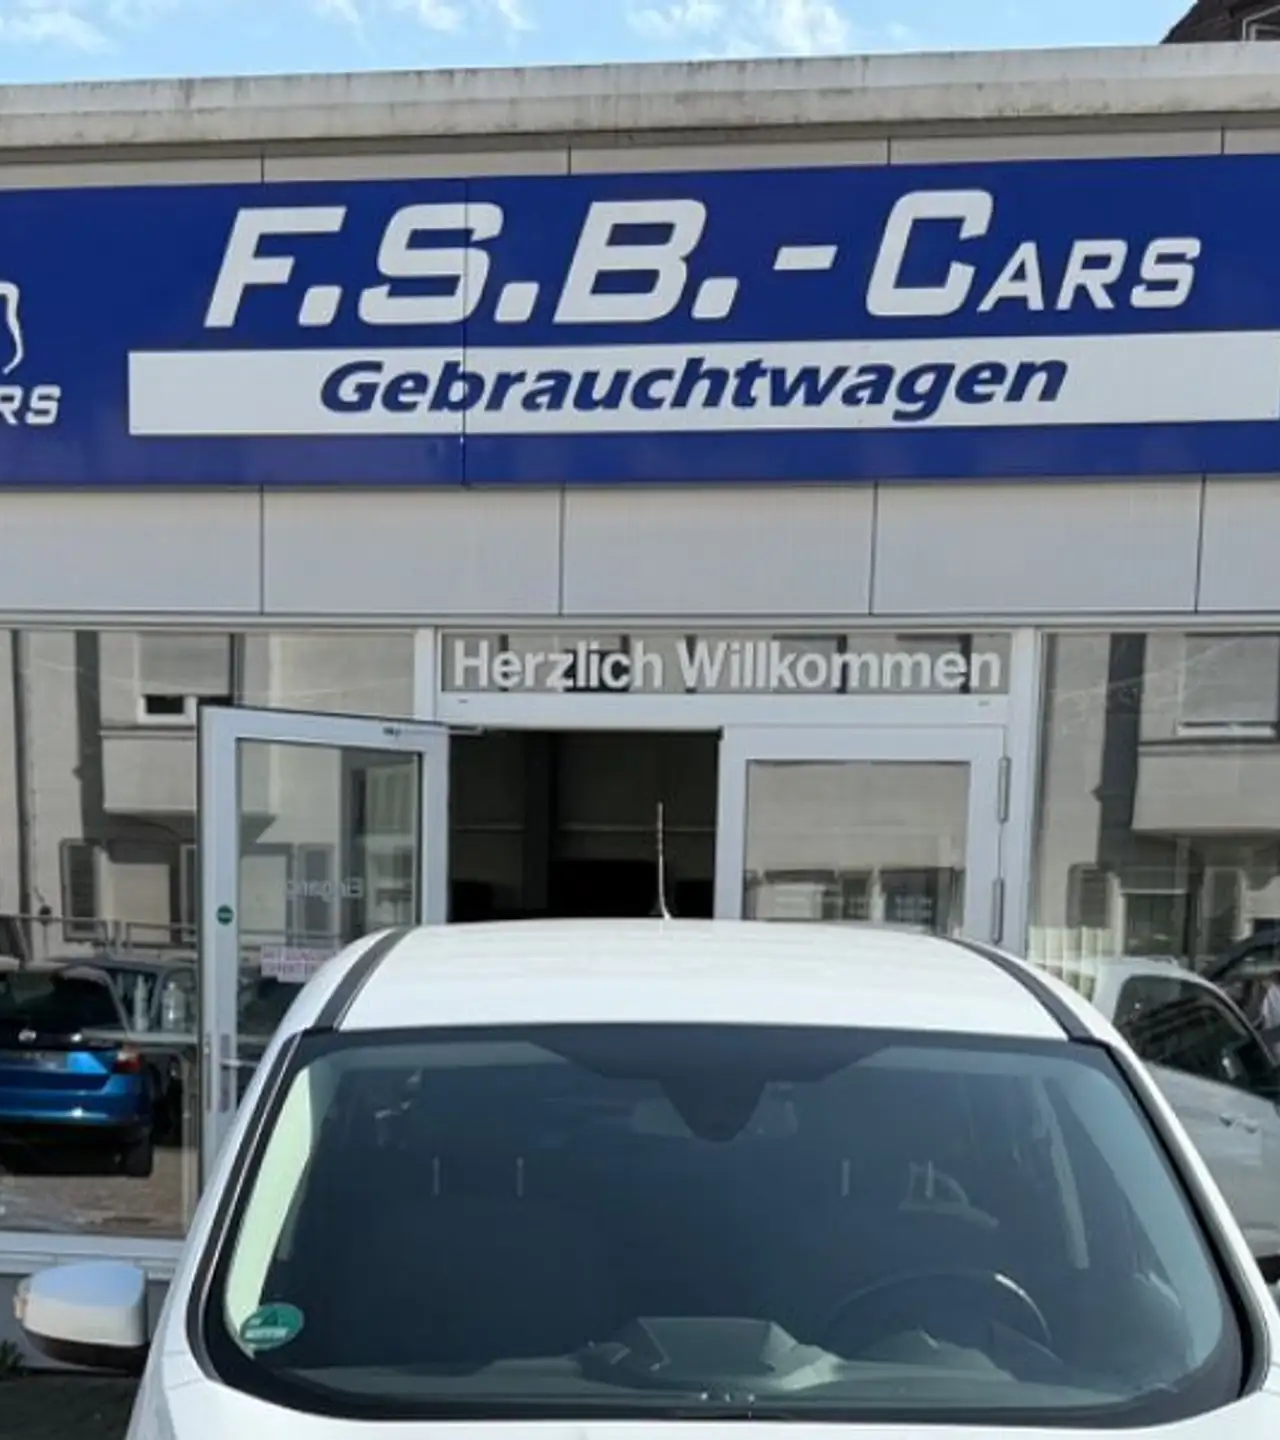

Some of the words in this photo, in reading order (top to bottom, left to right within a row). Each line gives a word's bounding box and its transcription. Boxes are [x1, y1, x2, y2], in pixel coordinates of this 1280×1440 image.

[321, 358, 1067, 421] Gebrauchtwagen
[452, 639, 663, 687] Herzlich
[677, 639, 1002, 689] Willkommen
